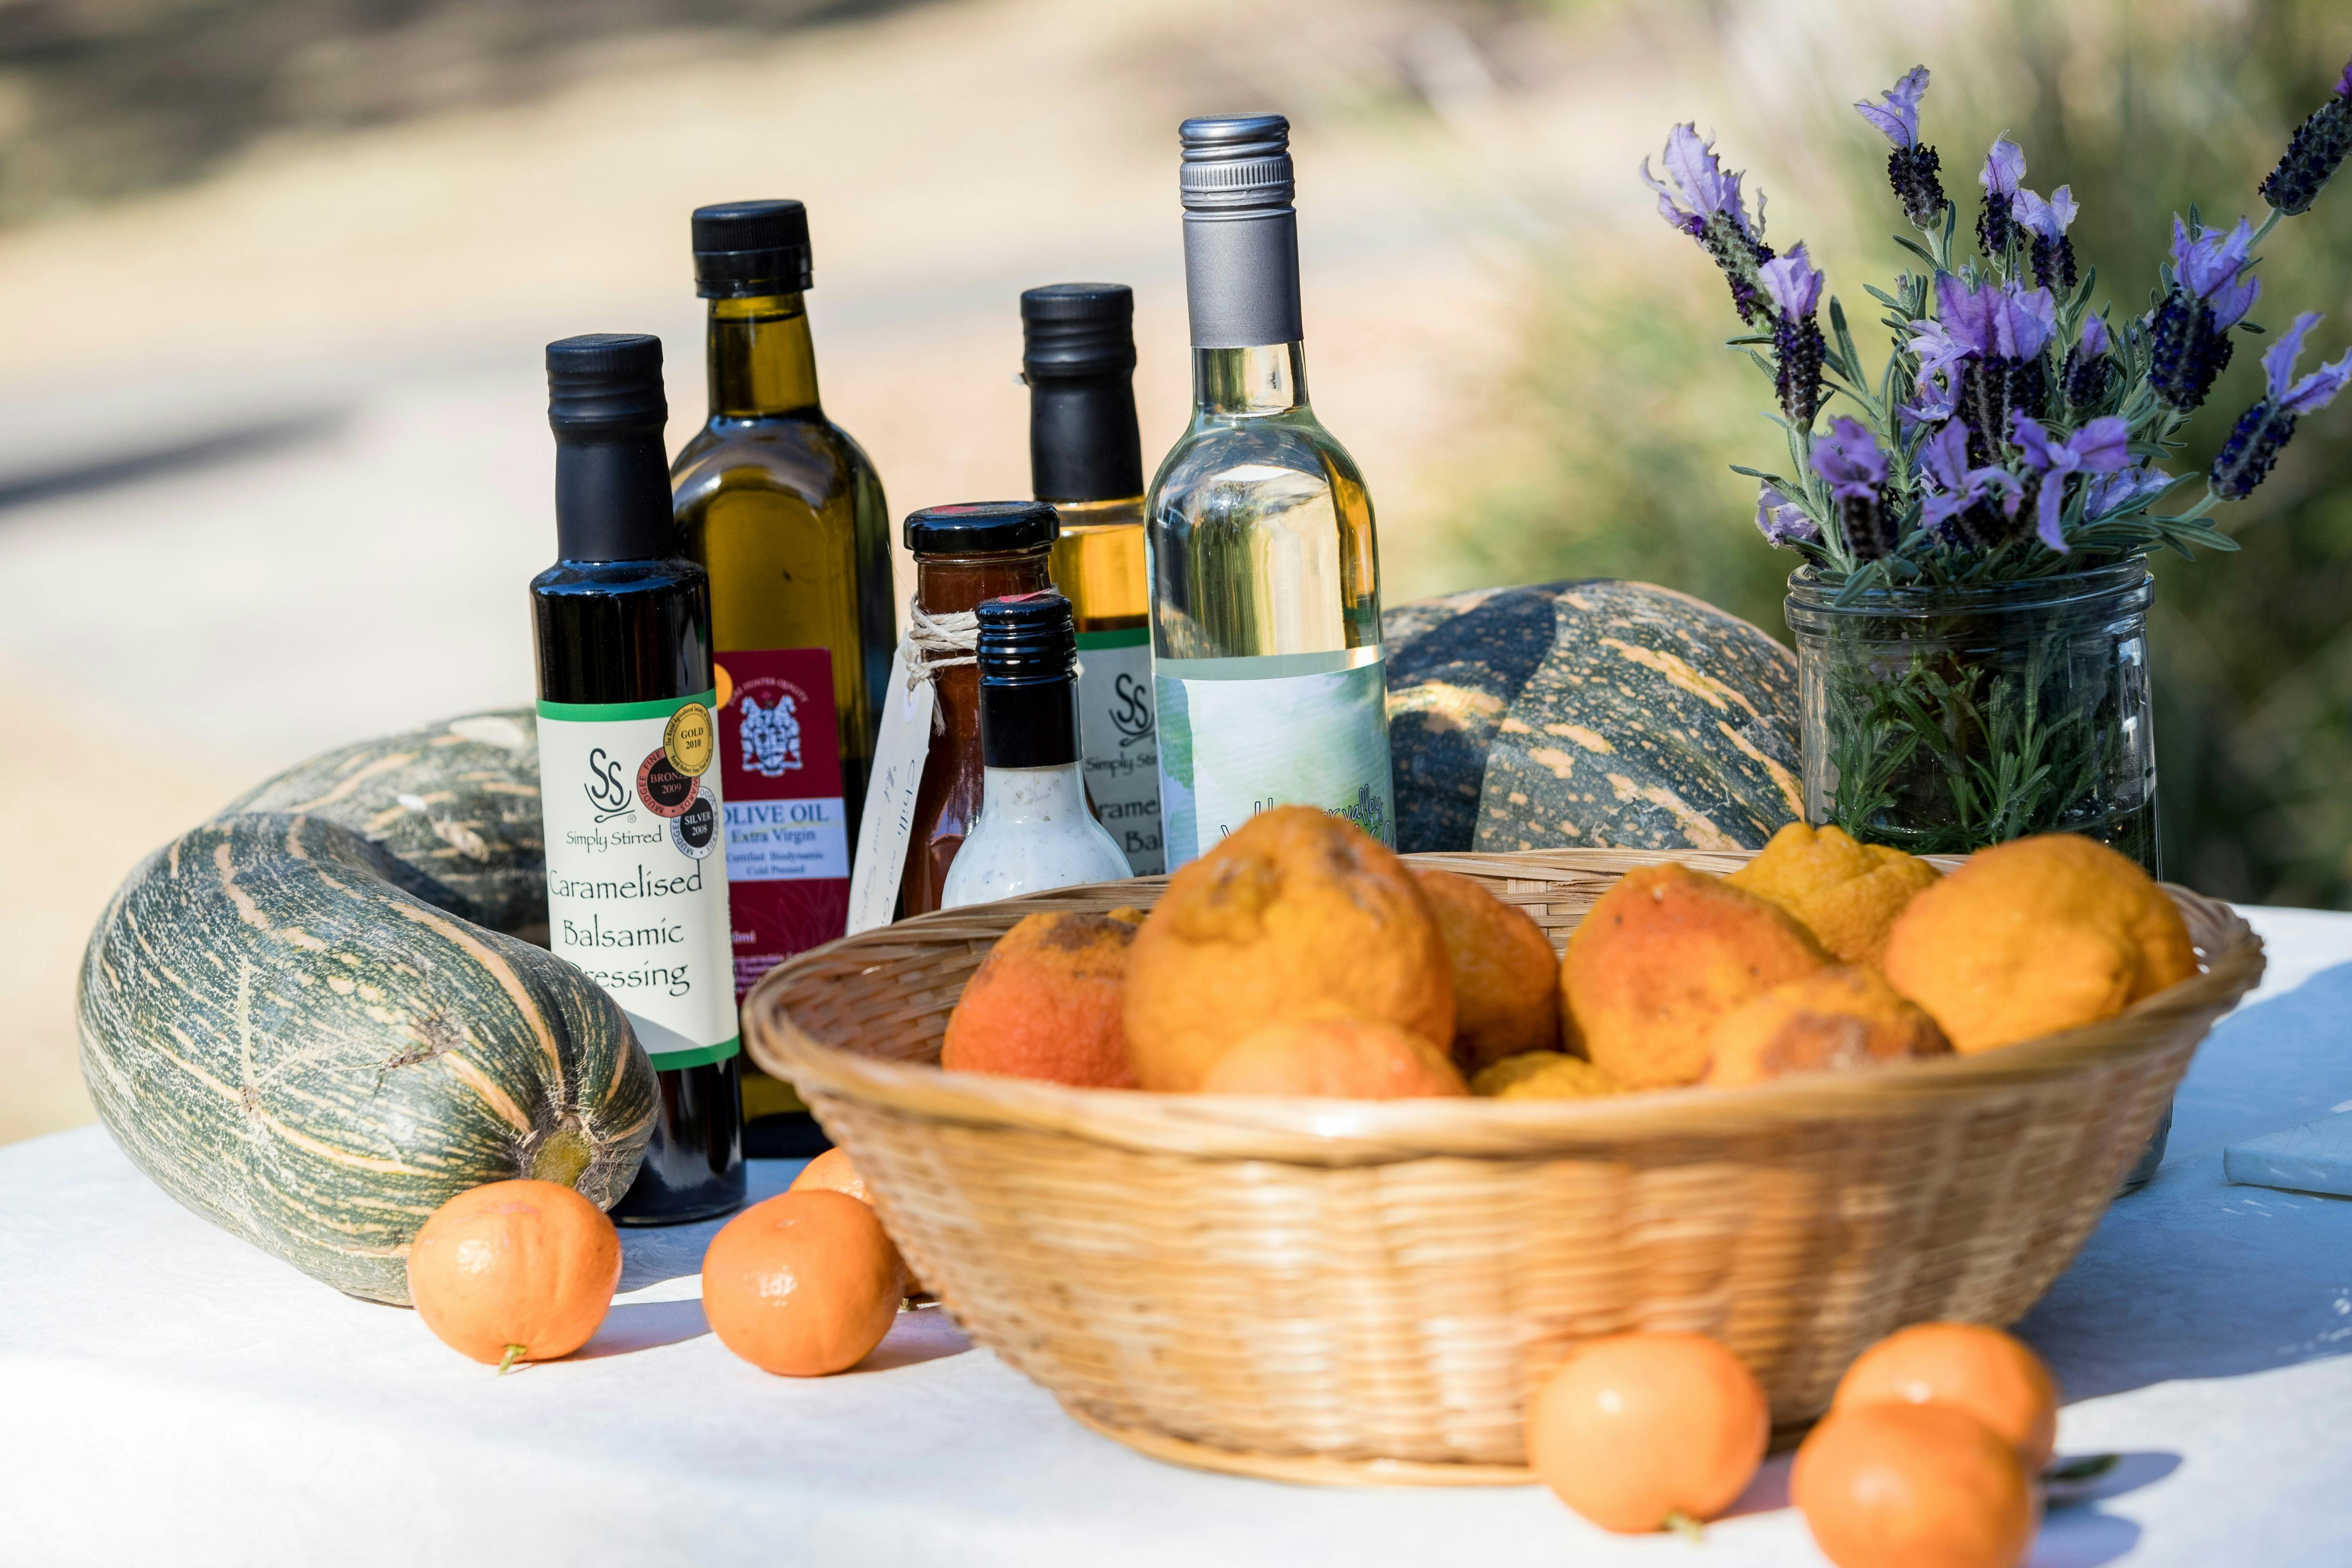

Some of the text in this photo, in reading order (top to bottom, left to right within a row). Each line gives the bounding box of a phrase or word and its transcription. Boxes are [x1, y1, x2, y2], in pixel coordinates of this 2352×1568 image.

[667, 721, 675, 736] Royal
[675, 705, 693, 723] Agricultural
[681, 727, 703, 739] GOLD
[686, 738, 701, 750] 2010
[670, 754, 679, 767] Royal
[679, 764, 692, 773] Hobart
[1085, 751, 1134, 777] Simply
[639, 751, 698, 814] MUDGEE FINE WARDS
[661, 783, 682, 794] 2009
[790, 803, 829, 823] OIL
[1342, 784, 1383, 825] valley
[673, 789, 718, 855] MUDGEE OODS AWARDS
[684, 811, 712, 825] SILVER
[566, 824, 662, 854] Simply Stirred
[692, 824, 708, 836] 2008
[732, 827, 816, 846] Extra Virgin
[1125, 821, 1163, 854] Bal
[770, 850, 824, 862] Biodynamic
[549, 859, 702, 899] Caramelised
[746, 864, 806, 875] Cold Pressed
[563, 913, 684, 948] Balsamic
[567, 960, 690, 997] ressing
